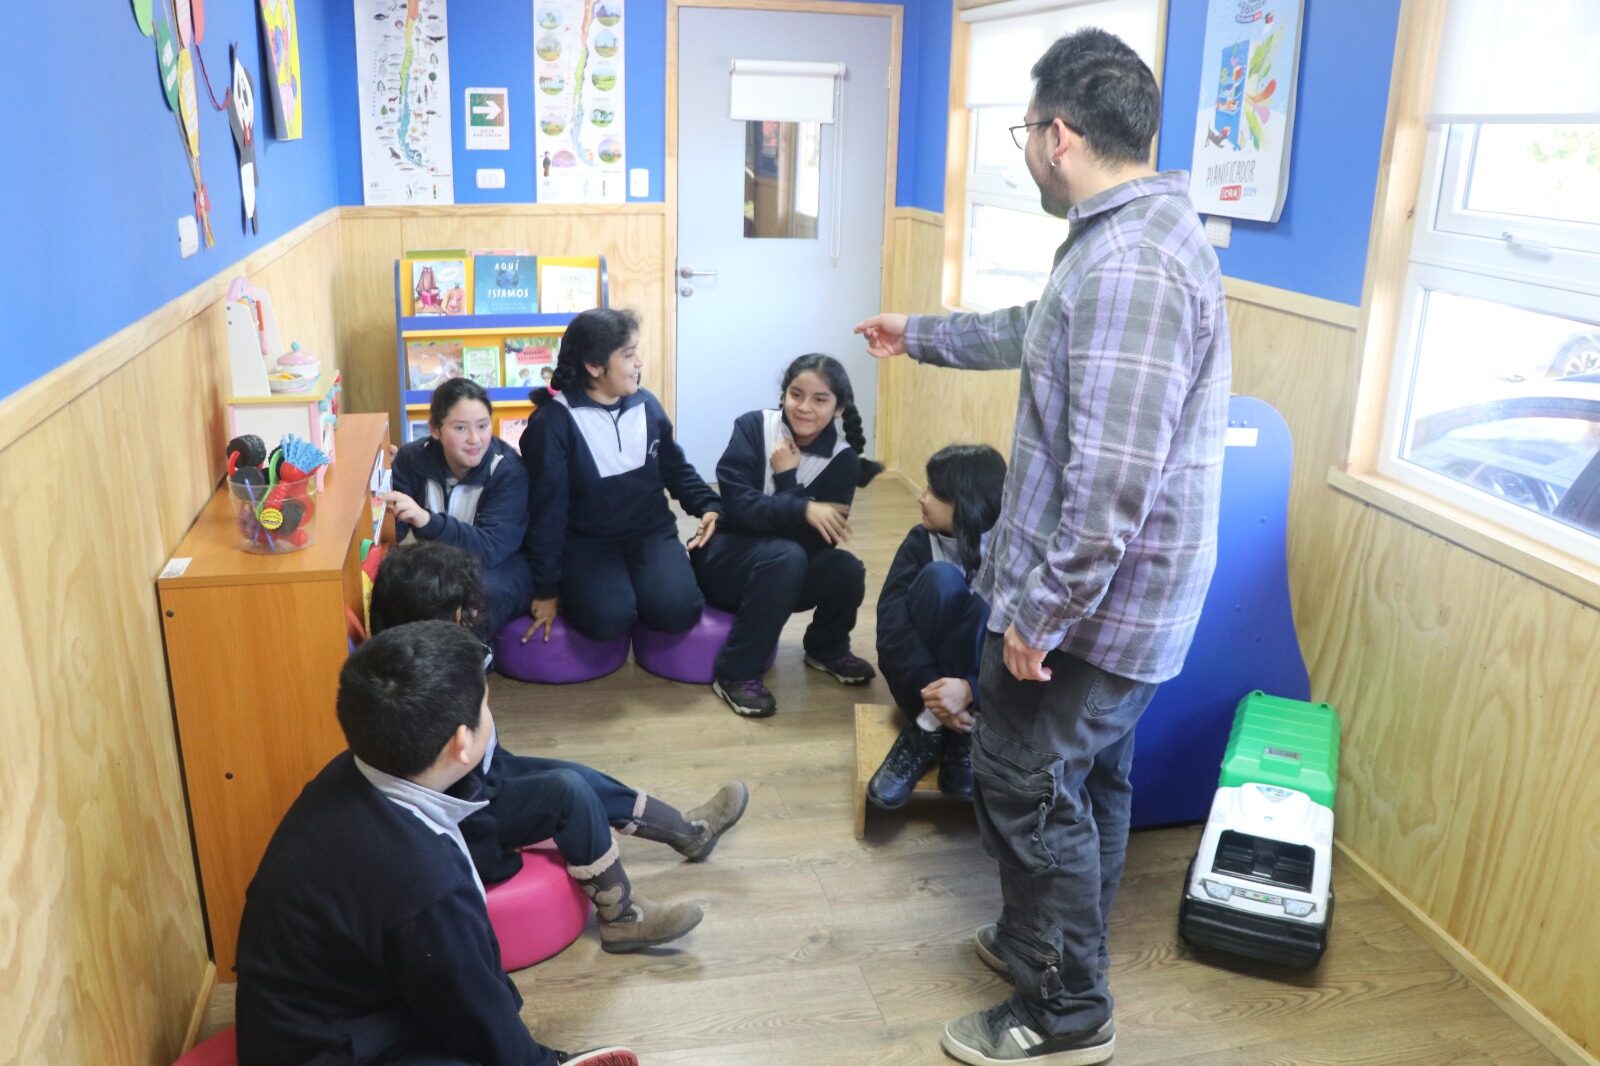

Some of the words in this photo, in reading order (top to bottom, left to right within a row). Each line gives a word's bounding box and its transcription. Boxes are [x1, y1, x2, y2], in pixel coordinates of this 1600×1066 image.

[1206, 160, 1256, 188] PLANIFICADOR
[494, 259, 520, 271] AQUÍ
[487, 288, 529, 299] ESTAMOS
